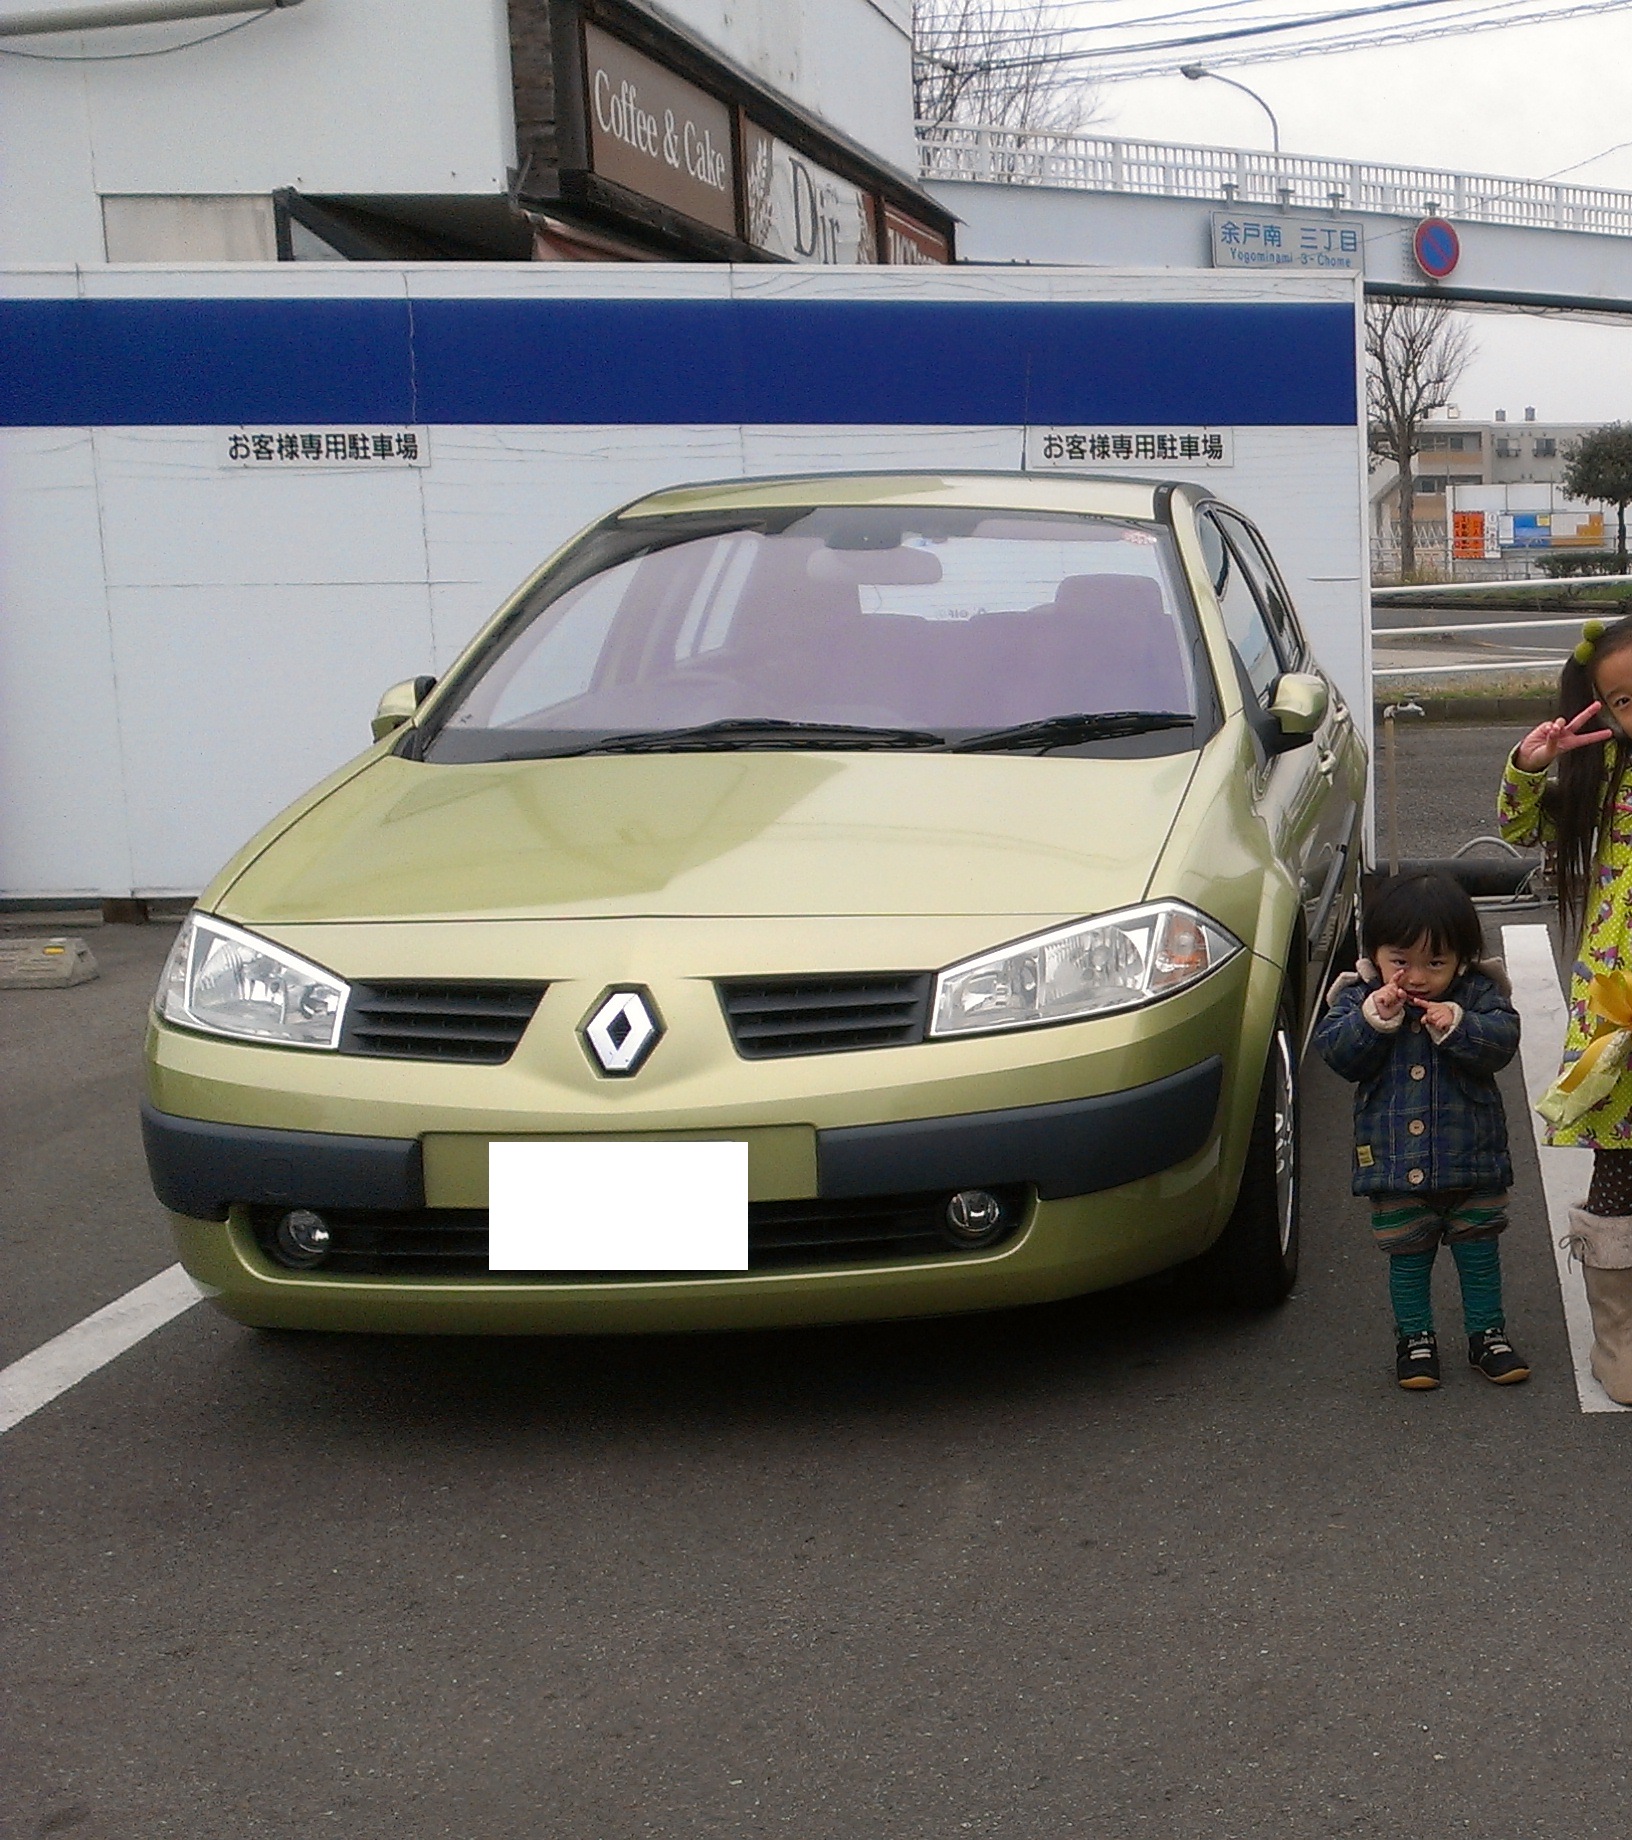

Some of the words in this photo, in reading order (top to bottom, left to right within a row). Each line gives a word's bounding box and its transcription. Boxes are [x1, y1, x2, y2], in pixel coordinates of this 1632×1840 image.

[594, 69, 659, 157] Coffee
[663, 108, 680, 169] &
[683, 119, 727, 192] Cake
[1220, 220, 1282, 248] 余戸南
[1300, 226, 1358, 252] 三丁目
[1230, 247, 1293, 263] Yogominami
[228, 432, 418, 461] お客様専用駐車場
[1043, 433, 1223, 460] お客様専用駐車場
